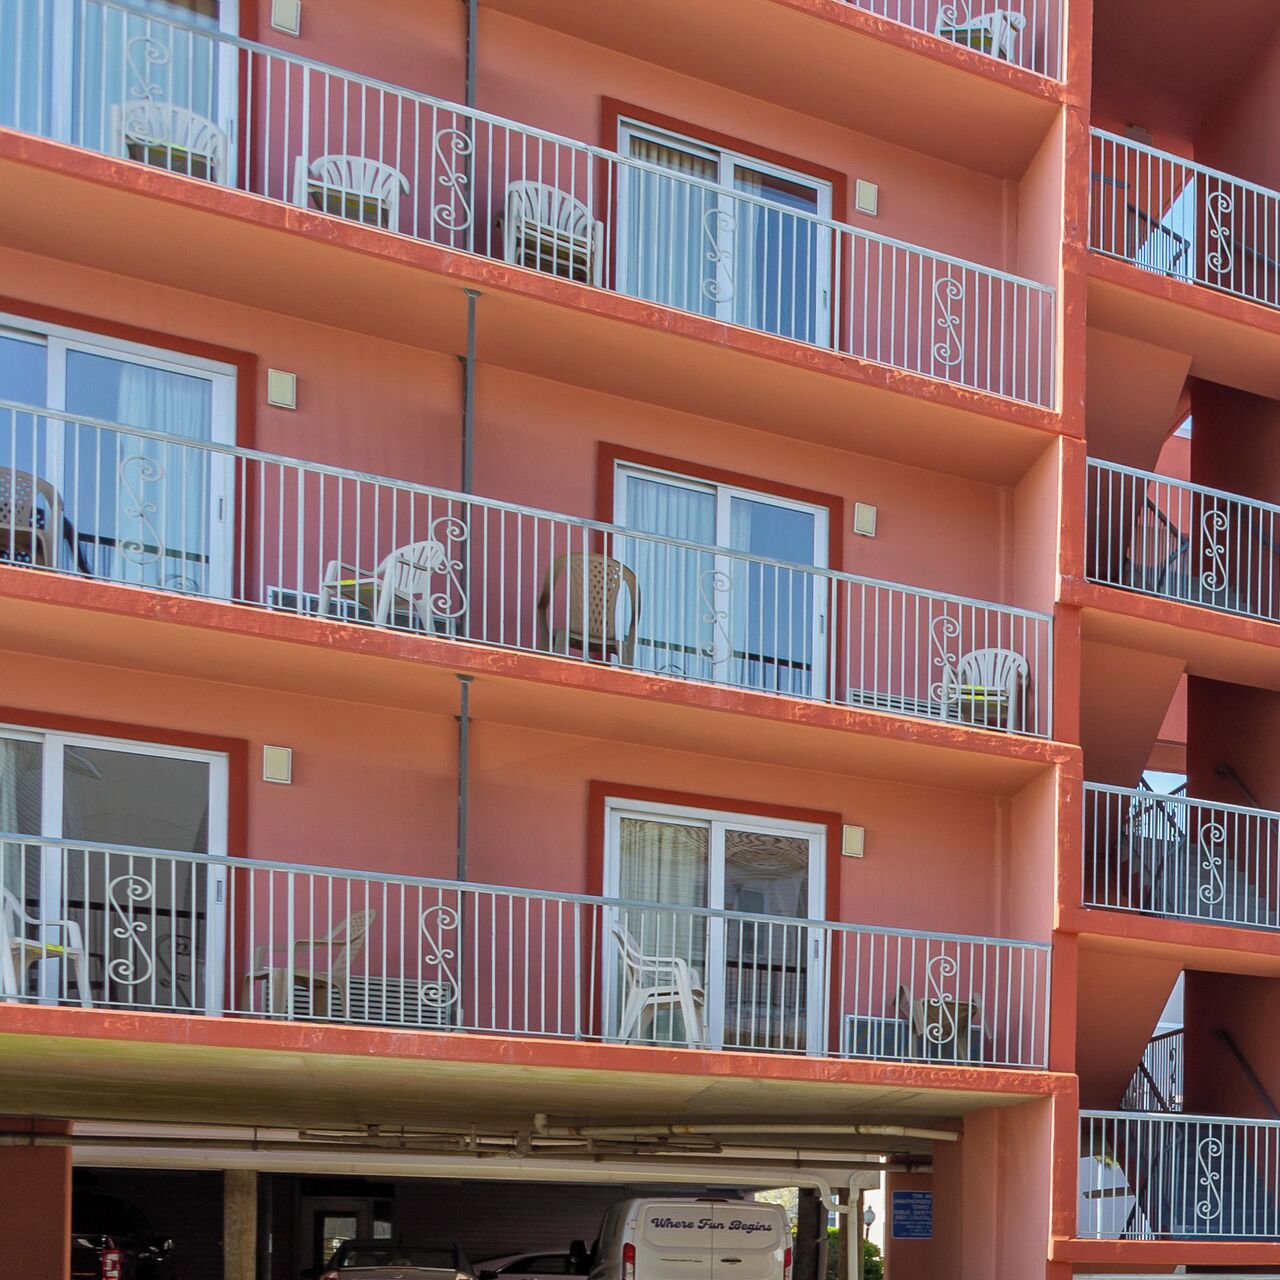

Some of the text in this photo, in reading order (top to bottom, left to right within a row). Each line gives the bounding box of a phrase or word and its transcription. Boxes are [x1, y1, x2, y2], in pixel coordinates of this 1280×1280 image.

[650, 1217, 773, 1234] Where Fun Begins
